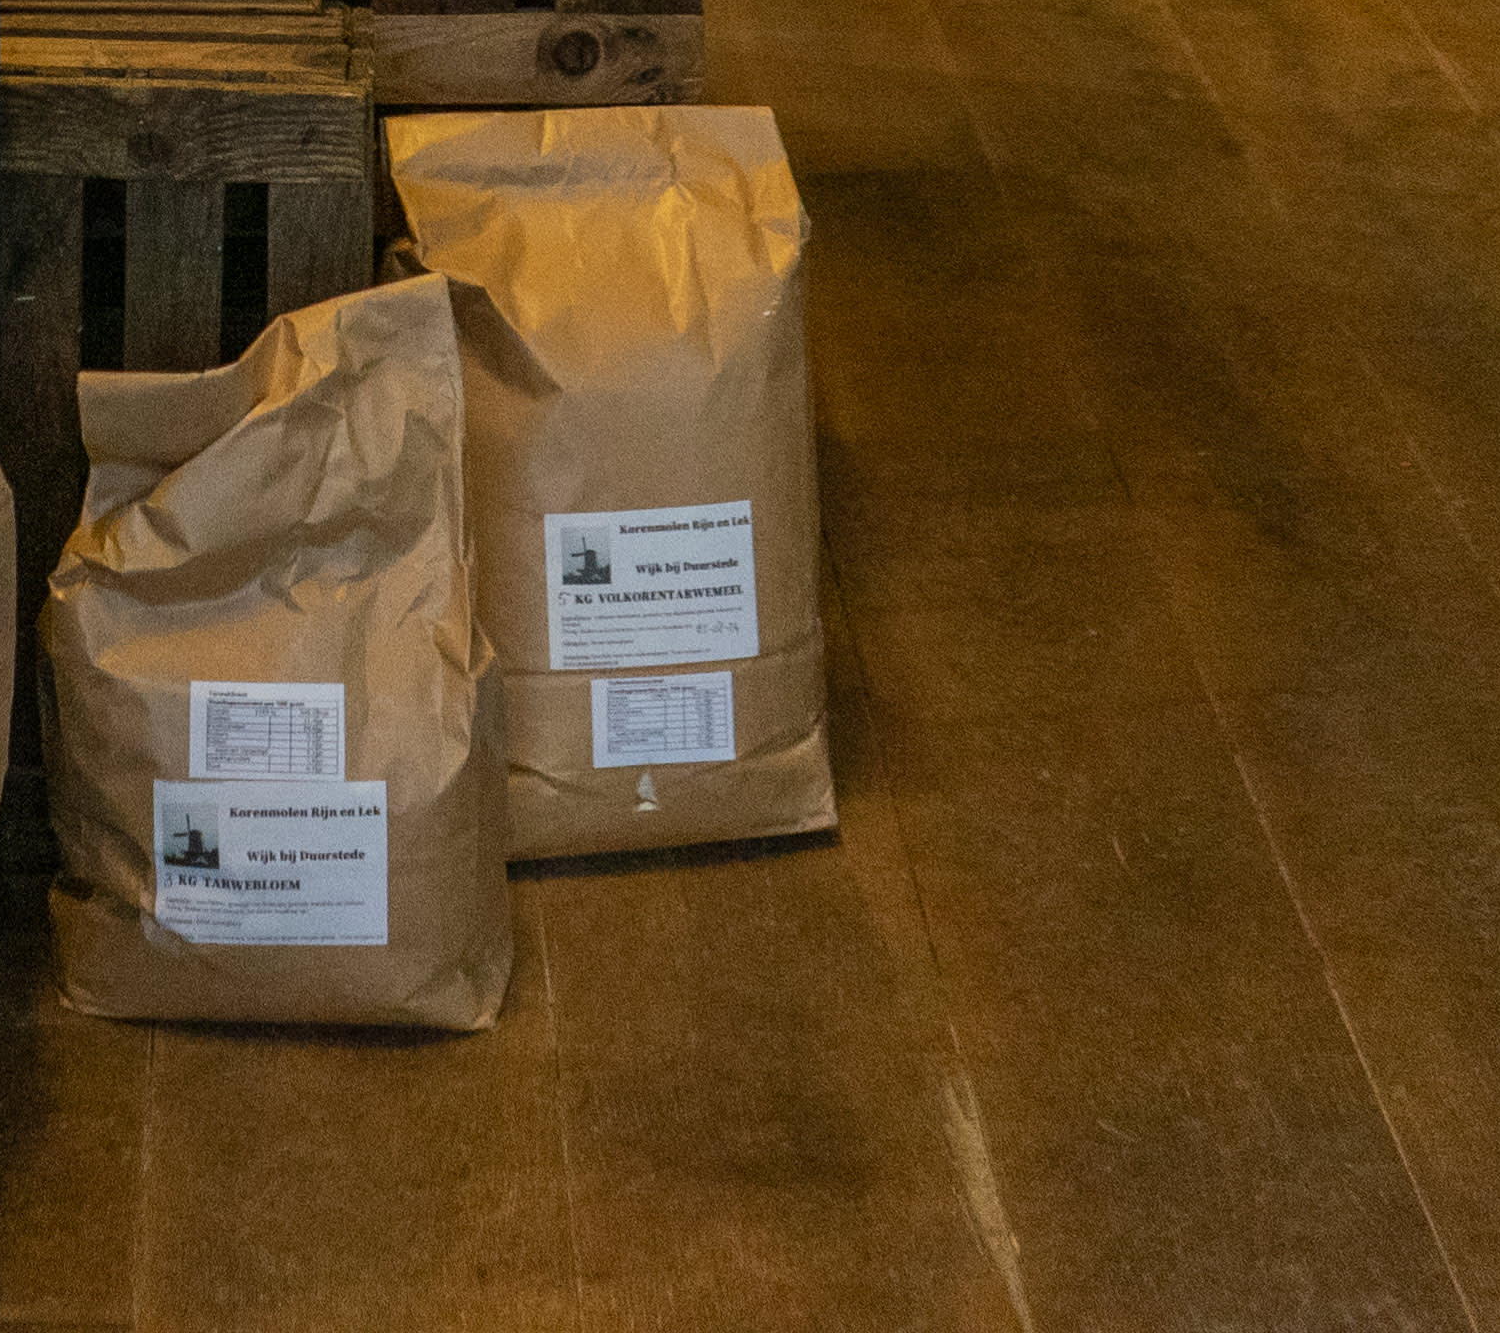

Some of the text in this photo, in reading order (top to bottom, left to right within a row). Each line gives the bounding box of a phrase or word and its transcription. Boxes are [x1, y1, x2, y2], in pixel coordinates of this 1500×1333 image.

[636, 563, 662, 577] Wijk
[664, 561, 680, 575] bij
[575, 594, 593, 605] KG
[598, 584, 744, 604] VOLKORENTARWEMEEL
[229, 805, 382, 821] Korenmolen Rijn en Lek
[247, 848, 367, 865] Wijk bij Duurstede
[178, 874, 198, 887] KG
[203, 877, 301, 891] TARWEBLOEM
